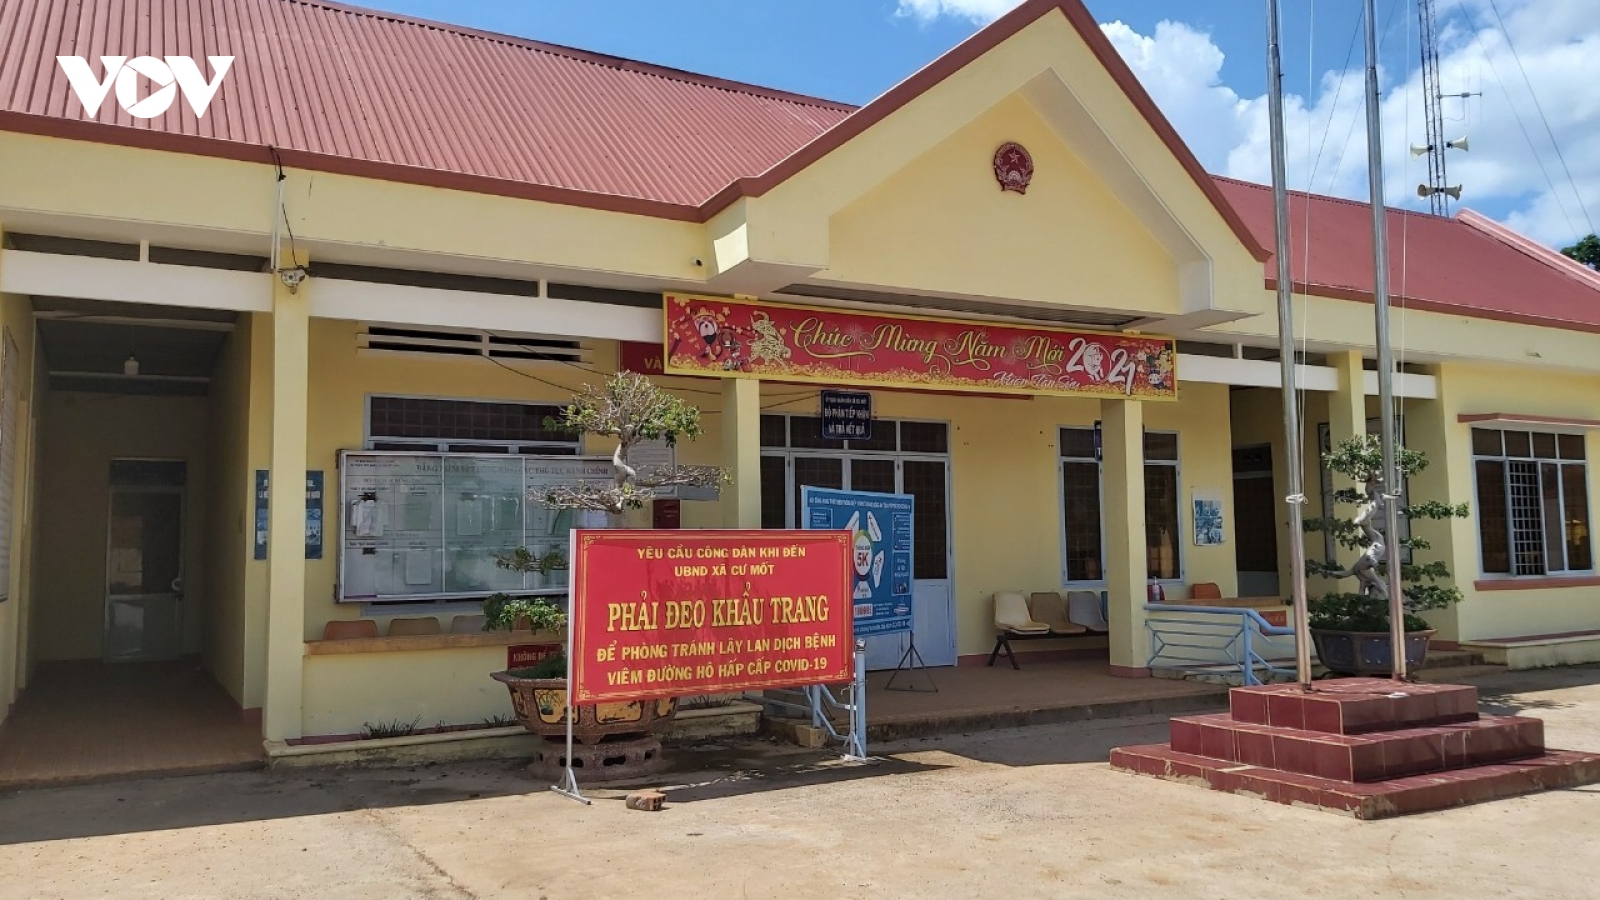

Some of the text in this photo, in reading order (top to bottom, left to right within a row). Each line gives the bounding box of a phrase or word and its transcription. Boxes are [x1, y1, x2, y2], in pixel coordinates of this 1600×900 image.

[789, 317, 1136, 396] Chúc Mừng Năm Mới 2021
[637, 543, 806, 559] YÊU CẦU CÔNG DÂN KHI ĐẾN
[675, 560, 775, 577] UBND XÃ CƯ MỐT
[607, 581, 829, 632] PHẢI ĐEO KHẨU TRANG
[596, 632, 836, 662] ĐỂ PHÒNG TRÁNH LÂY LAN DỊCH BỆNH
[607, 656, 827, 686] VIÊM ĐƯỜNG HÔ HẤP CẤP COVID-19
